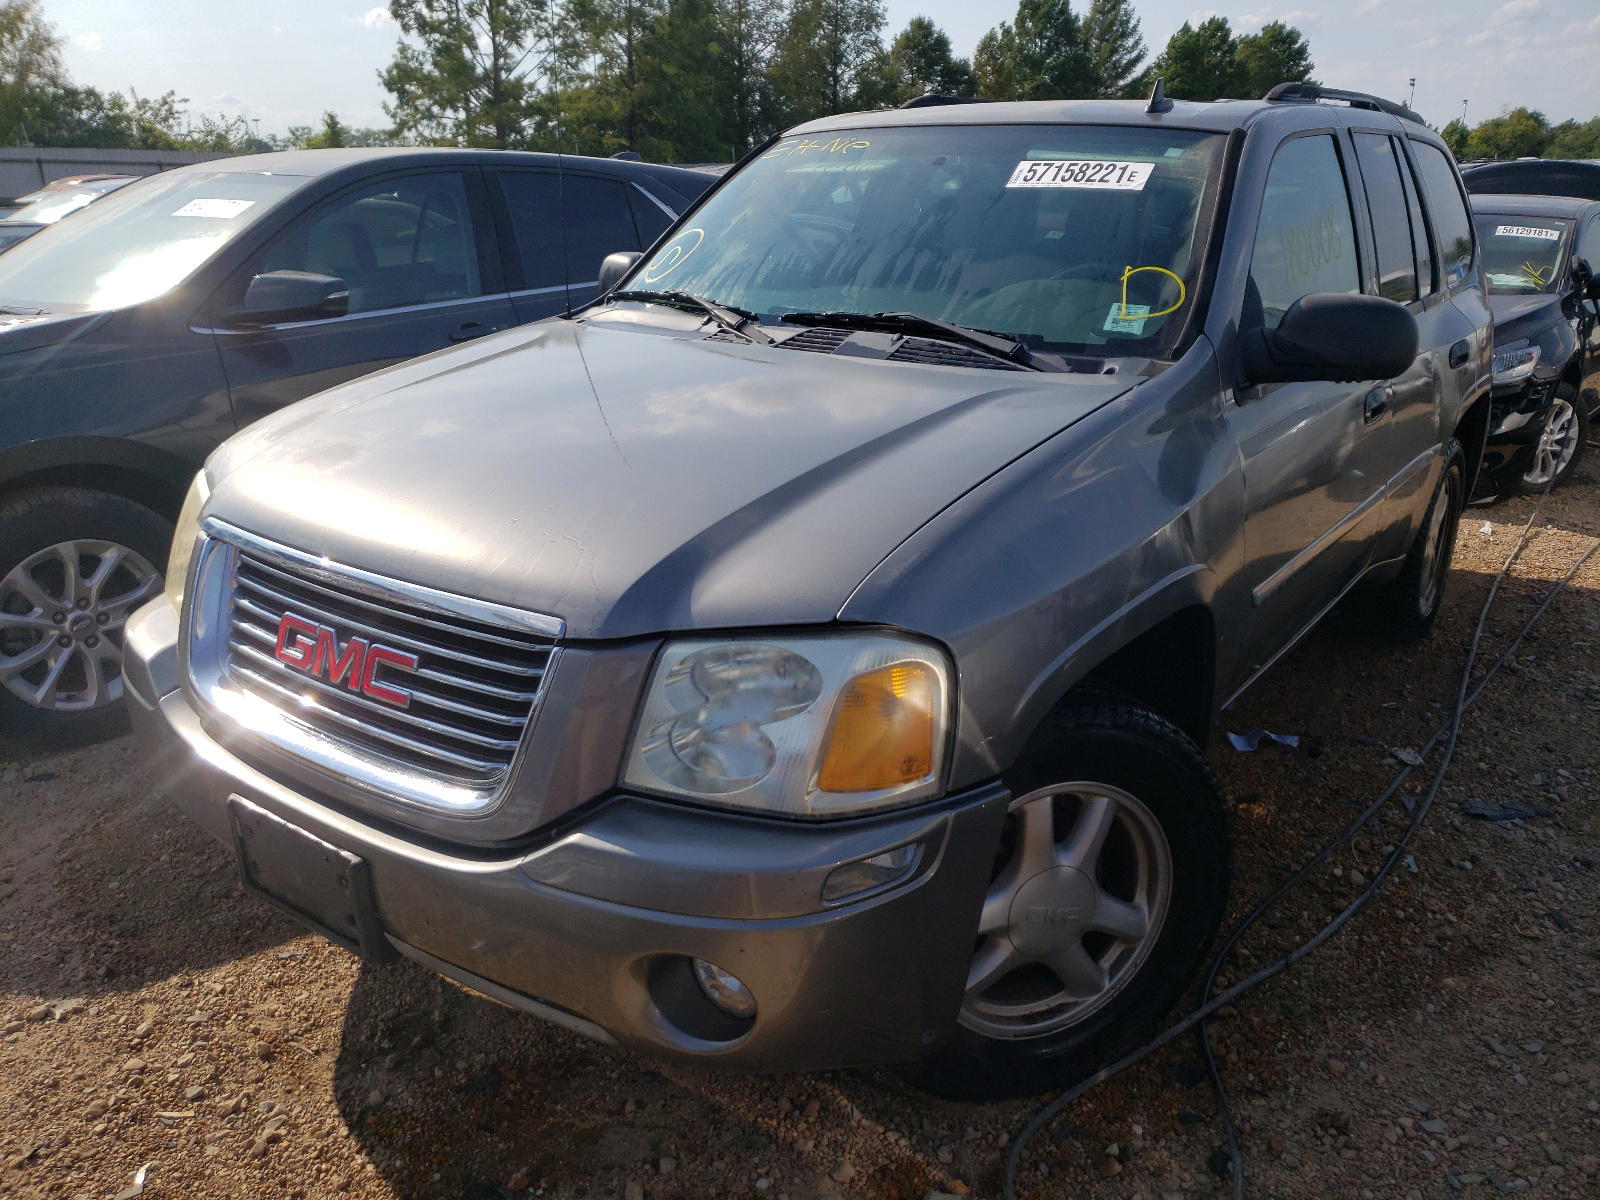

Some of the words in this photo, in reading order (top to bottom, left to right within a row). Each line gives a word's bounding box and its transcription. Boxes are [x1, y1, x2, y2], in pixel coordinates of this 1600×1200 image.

[1023, 162, 1130, 184] 57158221
[1502, 226, 1549, 237] 56129181
[275, 611, 419, 709] GMC
[1024, 906, 1081, 923] GMC
